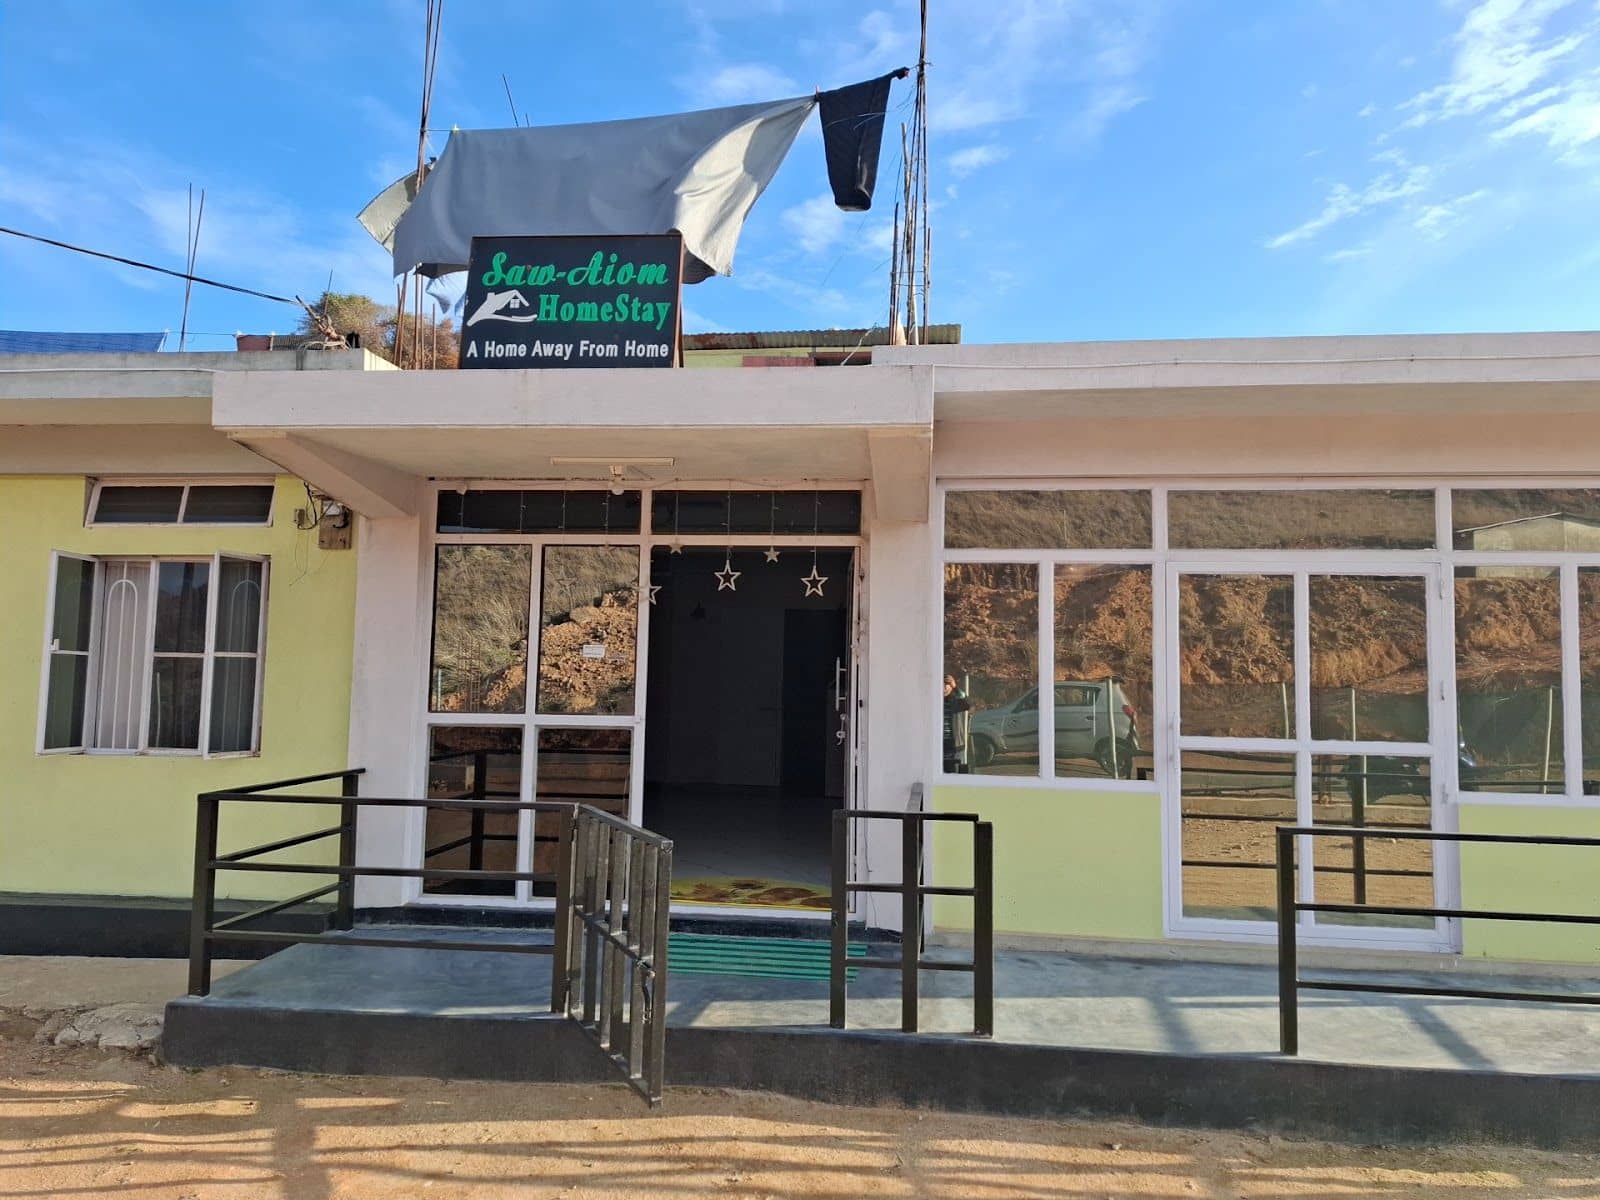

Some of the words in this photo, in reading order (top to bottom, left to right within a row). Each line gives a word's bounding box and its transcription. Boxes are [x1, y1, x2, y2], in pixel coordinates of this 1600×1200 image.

[482, 251, 669, 286] Saw-Aiom
[536, 293, 671, 331] HomeStay
[467, 340, 479, 358] A
[485, 340, 527, 358] Home
[531, 340, 573, 361] Away
[579, 340, 618, 358] From
[625, 340, 669, 358] Home
